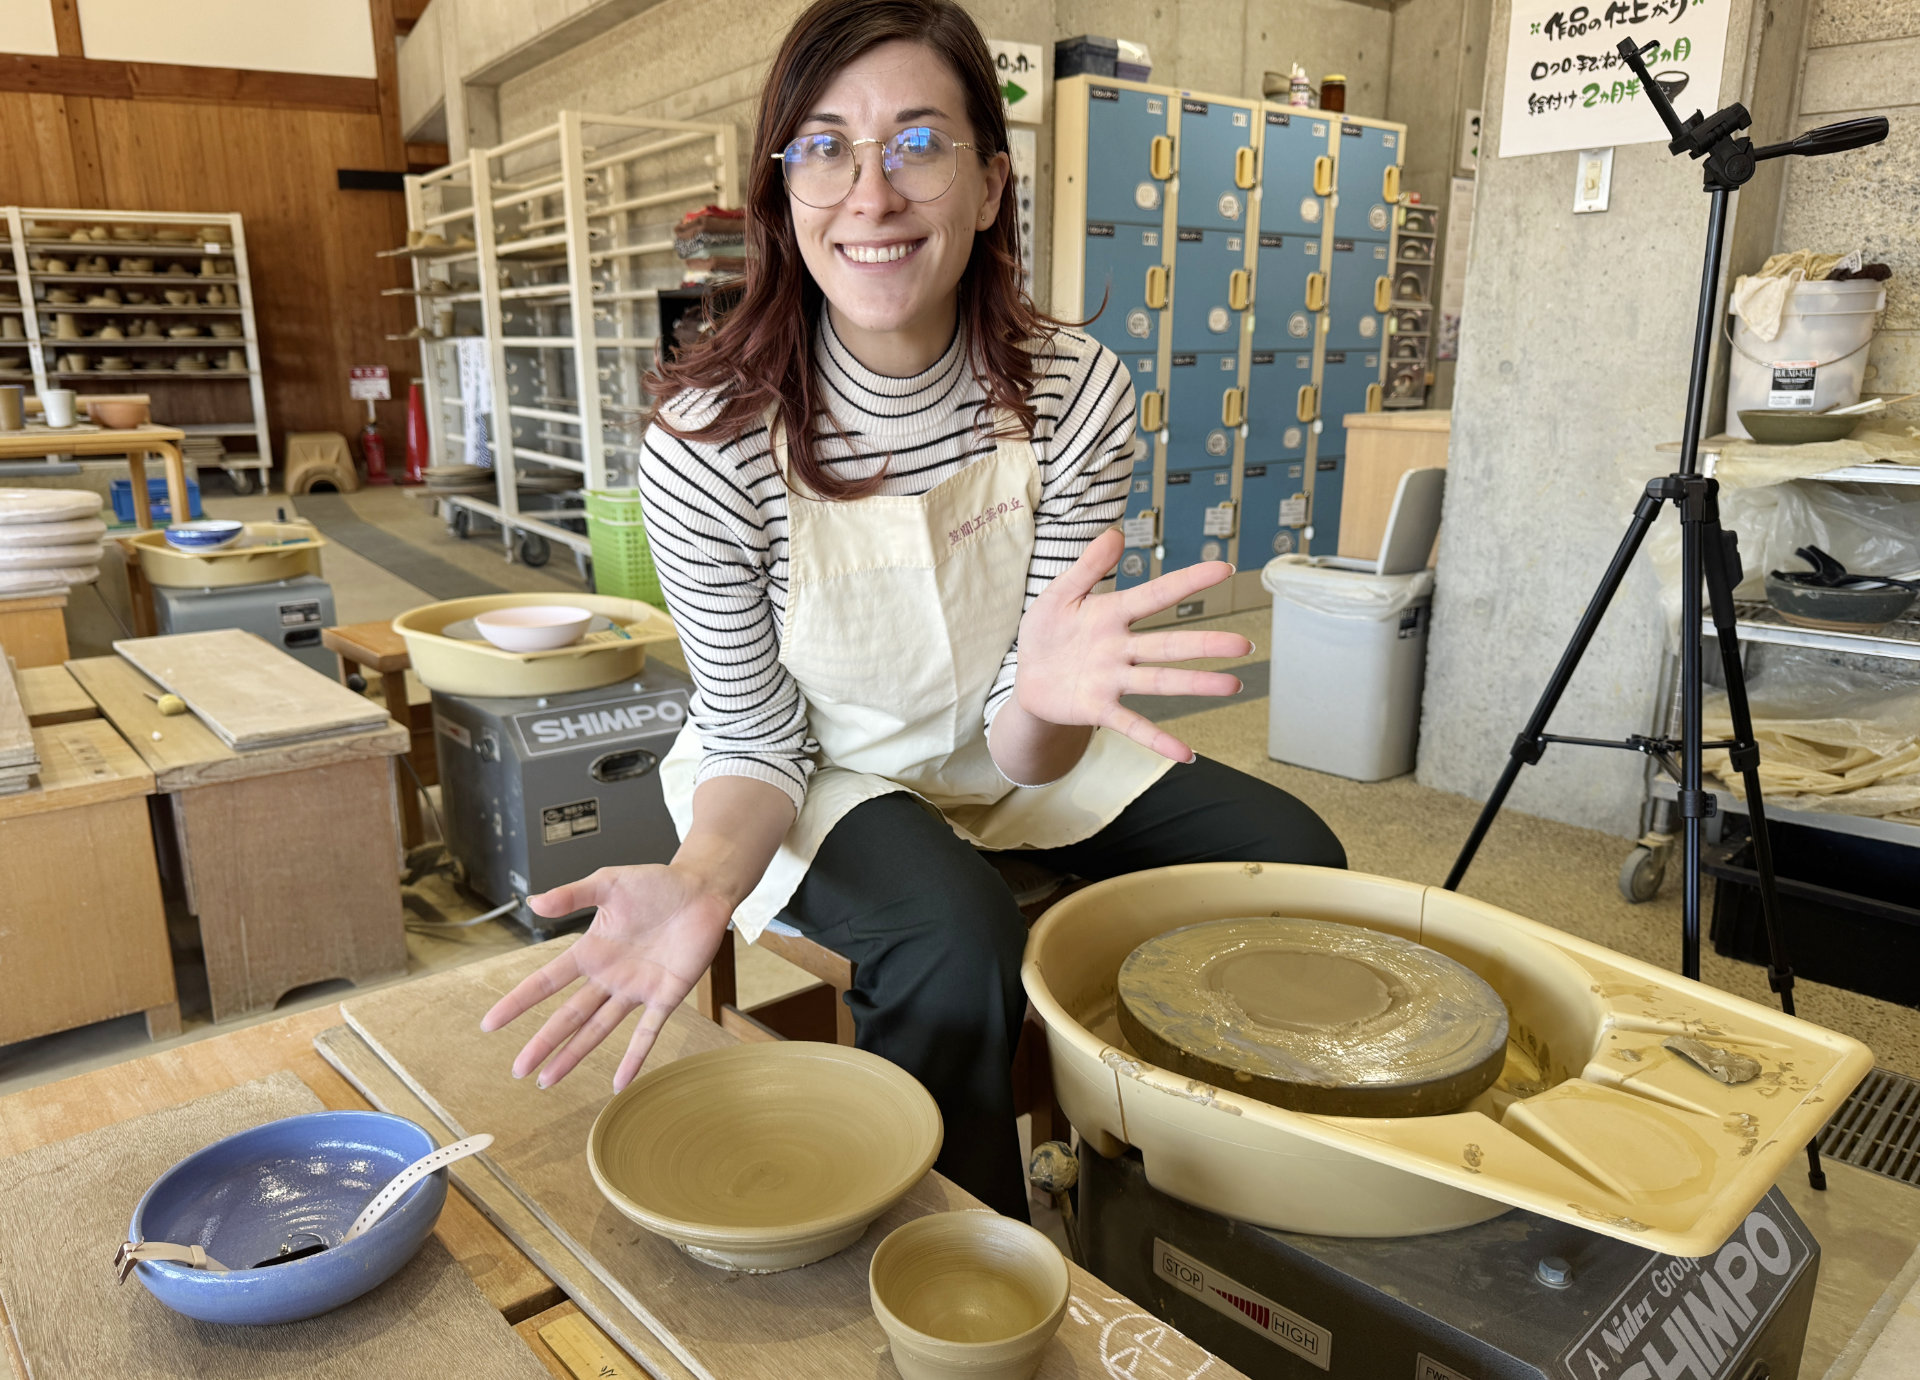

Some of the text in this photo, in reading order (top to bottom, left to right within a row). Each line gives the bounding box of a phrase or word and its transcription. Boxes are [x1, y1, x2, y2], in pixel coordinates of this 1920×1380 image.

[948, 497, 1024, 545] 笠間工芸の丘
[531, 700, 684, 743] SHIMPO
[1165, 1258, 1201, 1286] STOP
[1274, 1317, 1315, 1351] HIGH
[1585, 1347, 1610, 1380] A
[1601, 1291, 1659, 1354] Nidec
